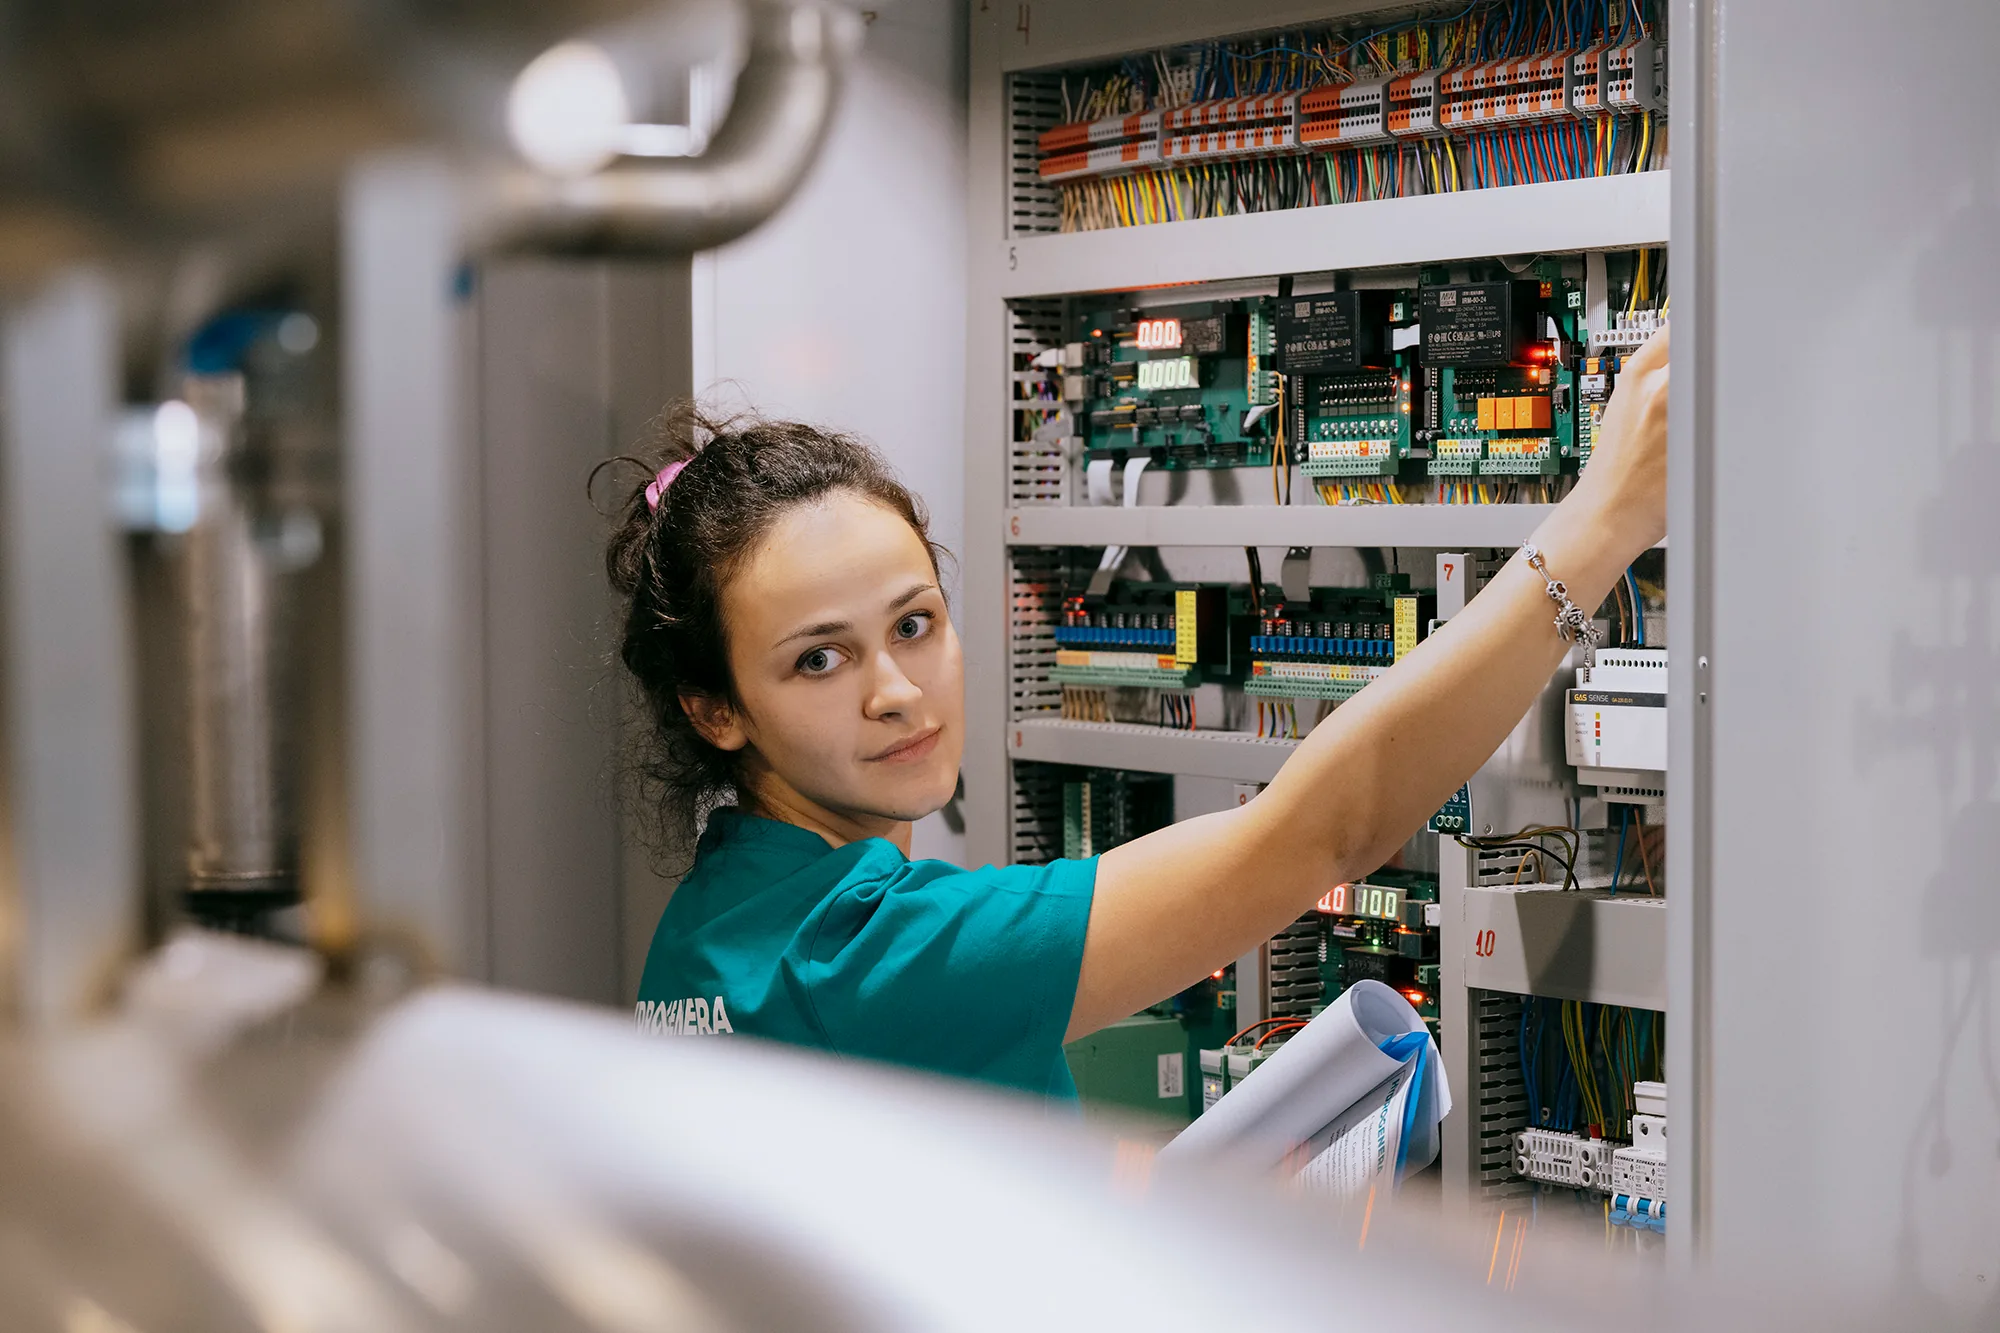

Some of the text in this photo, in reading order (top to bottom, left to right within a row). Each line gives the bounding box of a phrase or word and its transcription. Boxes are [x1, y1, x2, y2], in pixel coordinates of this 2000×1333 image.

[1017, 4, 1030, 45] 4
[1009, 246, 1018, 270] 5
[1011, 516, 1020, 537] 6
[1443, 564, 1454, 581] 7
[1588, 694, 1608, 702] SENSE
[1361, 888, 1397, 918] 100
[1476, 930, 1496, 957] 10
